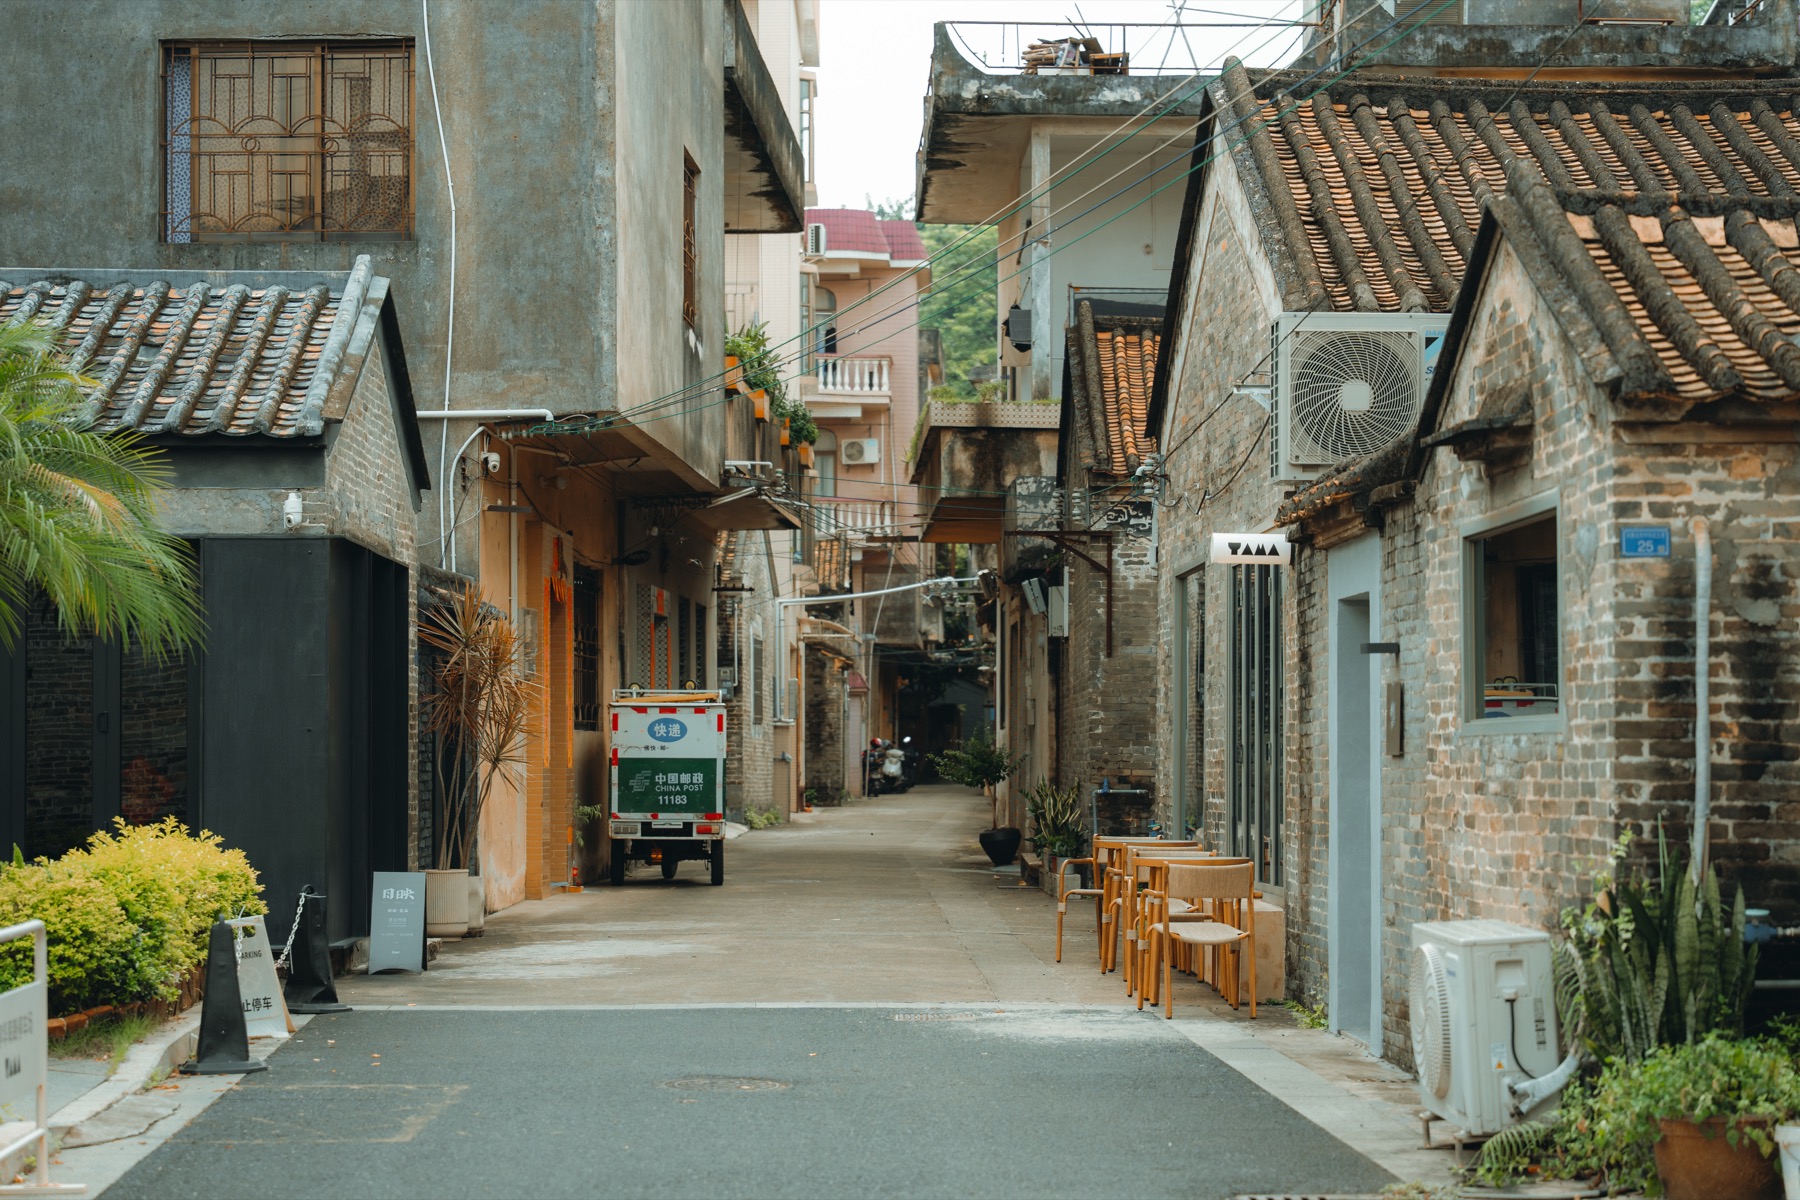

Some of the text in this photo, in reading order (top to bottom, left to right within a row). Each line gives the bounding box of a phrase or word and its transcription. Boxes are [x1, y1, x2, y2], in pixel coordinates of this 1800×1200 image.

[1228, 542, 1280, 556] YAMA
[1637, 539, 1655, 552] 25
[654, 723, 681, 737] 快递
[655, 772, 704, 784] 中国邮政
[658, 795, 687, 805] 11183
[239, 950, 262, 959] ARKING
[241, 996, 273, 1013] 止停车
